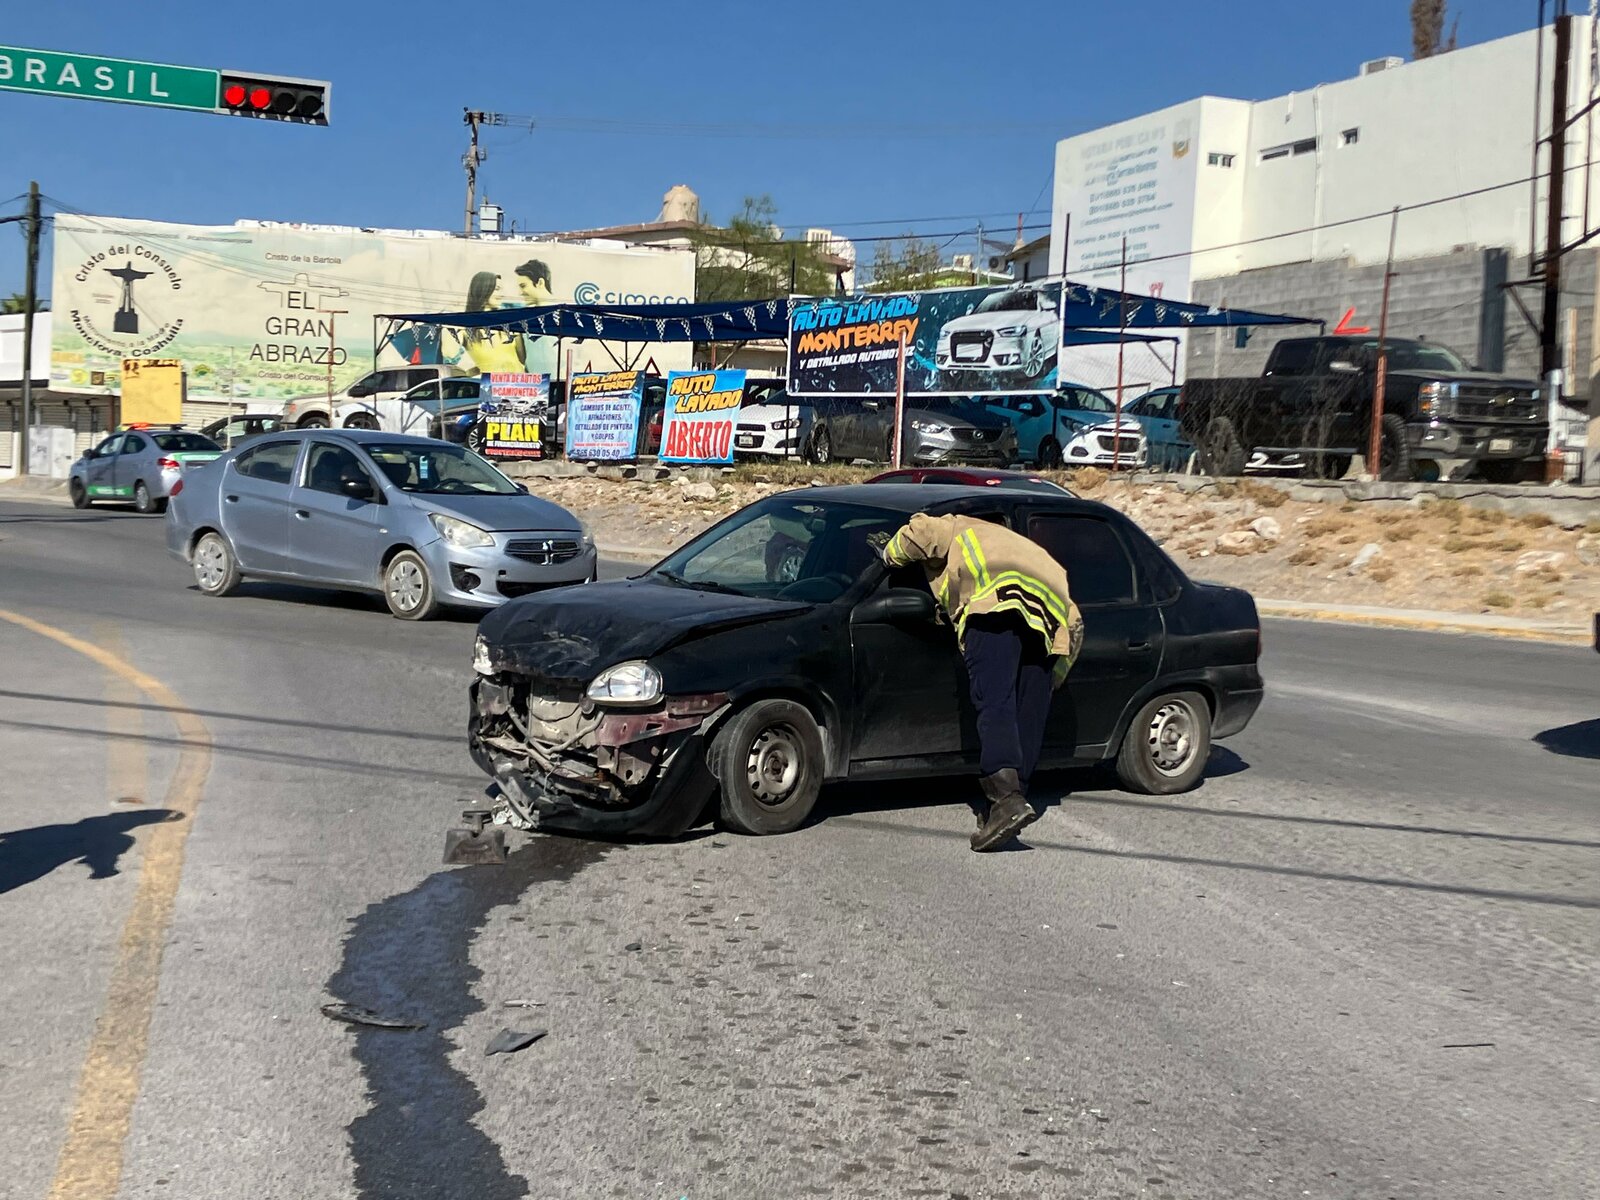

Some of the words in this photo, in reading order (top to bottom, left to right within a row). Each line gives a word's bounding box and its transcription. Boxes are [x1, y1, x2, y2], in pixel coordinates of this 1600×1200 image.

[0, 56, 169, 97] BRASIL
[75, 251, 105, 282] Cristo
[109, 244, 130, 256] del
[134, 245, 182, 290] Consuelo
[290, 255, 302, 263] de
[287, 290, 315, 310] EL
[793, 307, 842, 331] AUTO
[845, 297, 920, 324] LAVADO
[265, 316, 333, 338] GRAN
[797, 317, 919, 354] MONTERREY
[249, 343, 347, 366] ABRAZO
[800, 359, 807, 370] Y
[807, 352, 857, 369] DETALLADO
[491, 373, 510, 383] VENTA
[511, 374, 520, 383] DE
[521, 374, 541, 384] AUTOS
[573, 375, 600, 385] AUTO
[601, 371, 638, 383] LAVADO
[573, 380, 636, 393] MONTERREY
[669, 374, 716, 396] AUTO
[580, 404, 604, 412] CAMBIOS
[675, 389, 743, 414] LAVADO
[486, 423, 539, 442] PLAN
[663, 420, 733, 459] ABIERTO
